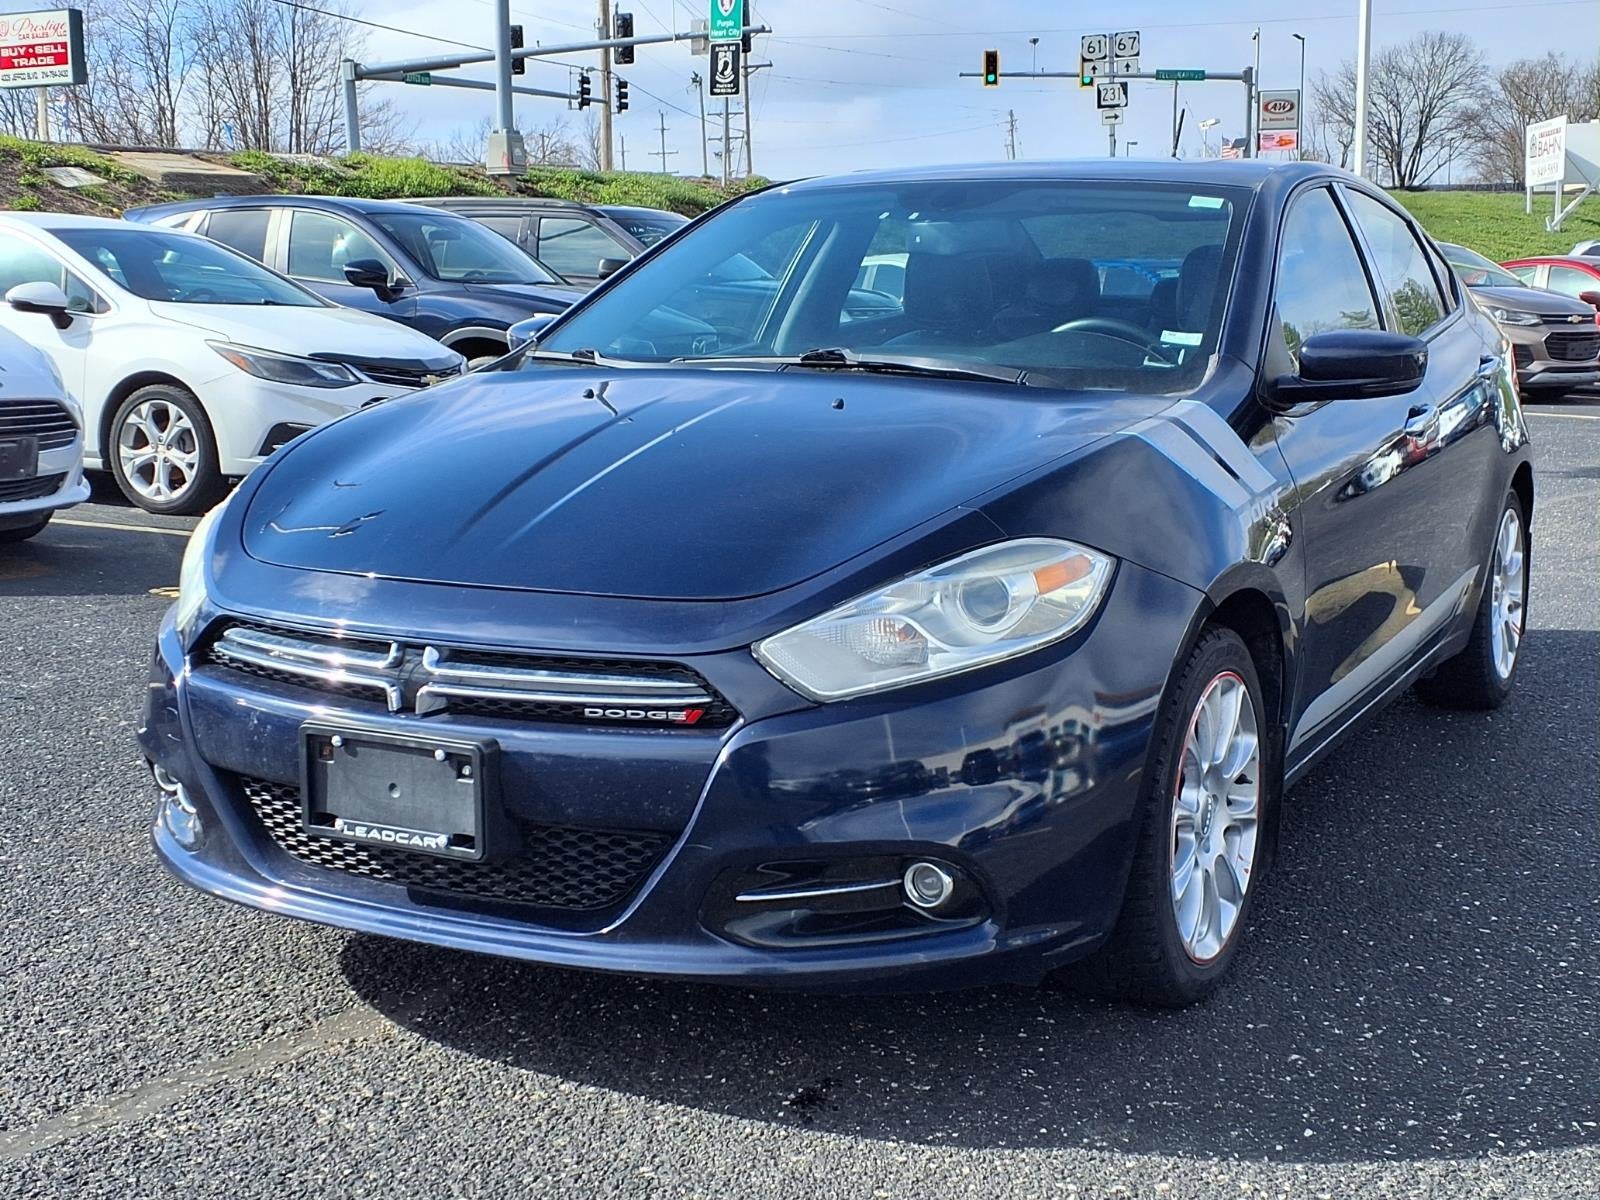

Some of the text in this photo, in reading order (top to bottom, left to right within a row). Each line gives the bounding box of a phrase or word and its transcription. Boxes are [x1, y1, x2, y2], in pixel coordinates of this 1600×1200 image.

[728, 28, 740, 36] City
[0, 43, 66, 57] BUY SELL
[1087, 40, 1102, 54] 61
[1117, 36, 1137, 51] 67
[11, 55, 55, 67] TRADE
[1102, 87, 1121, 102] 231
[1537, 135, 1562, 157] BAHN
[584, 708, 687, 720] DODGE
[343, 824, 438, 848] LEADCAR
